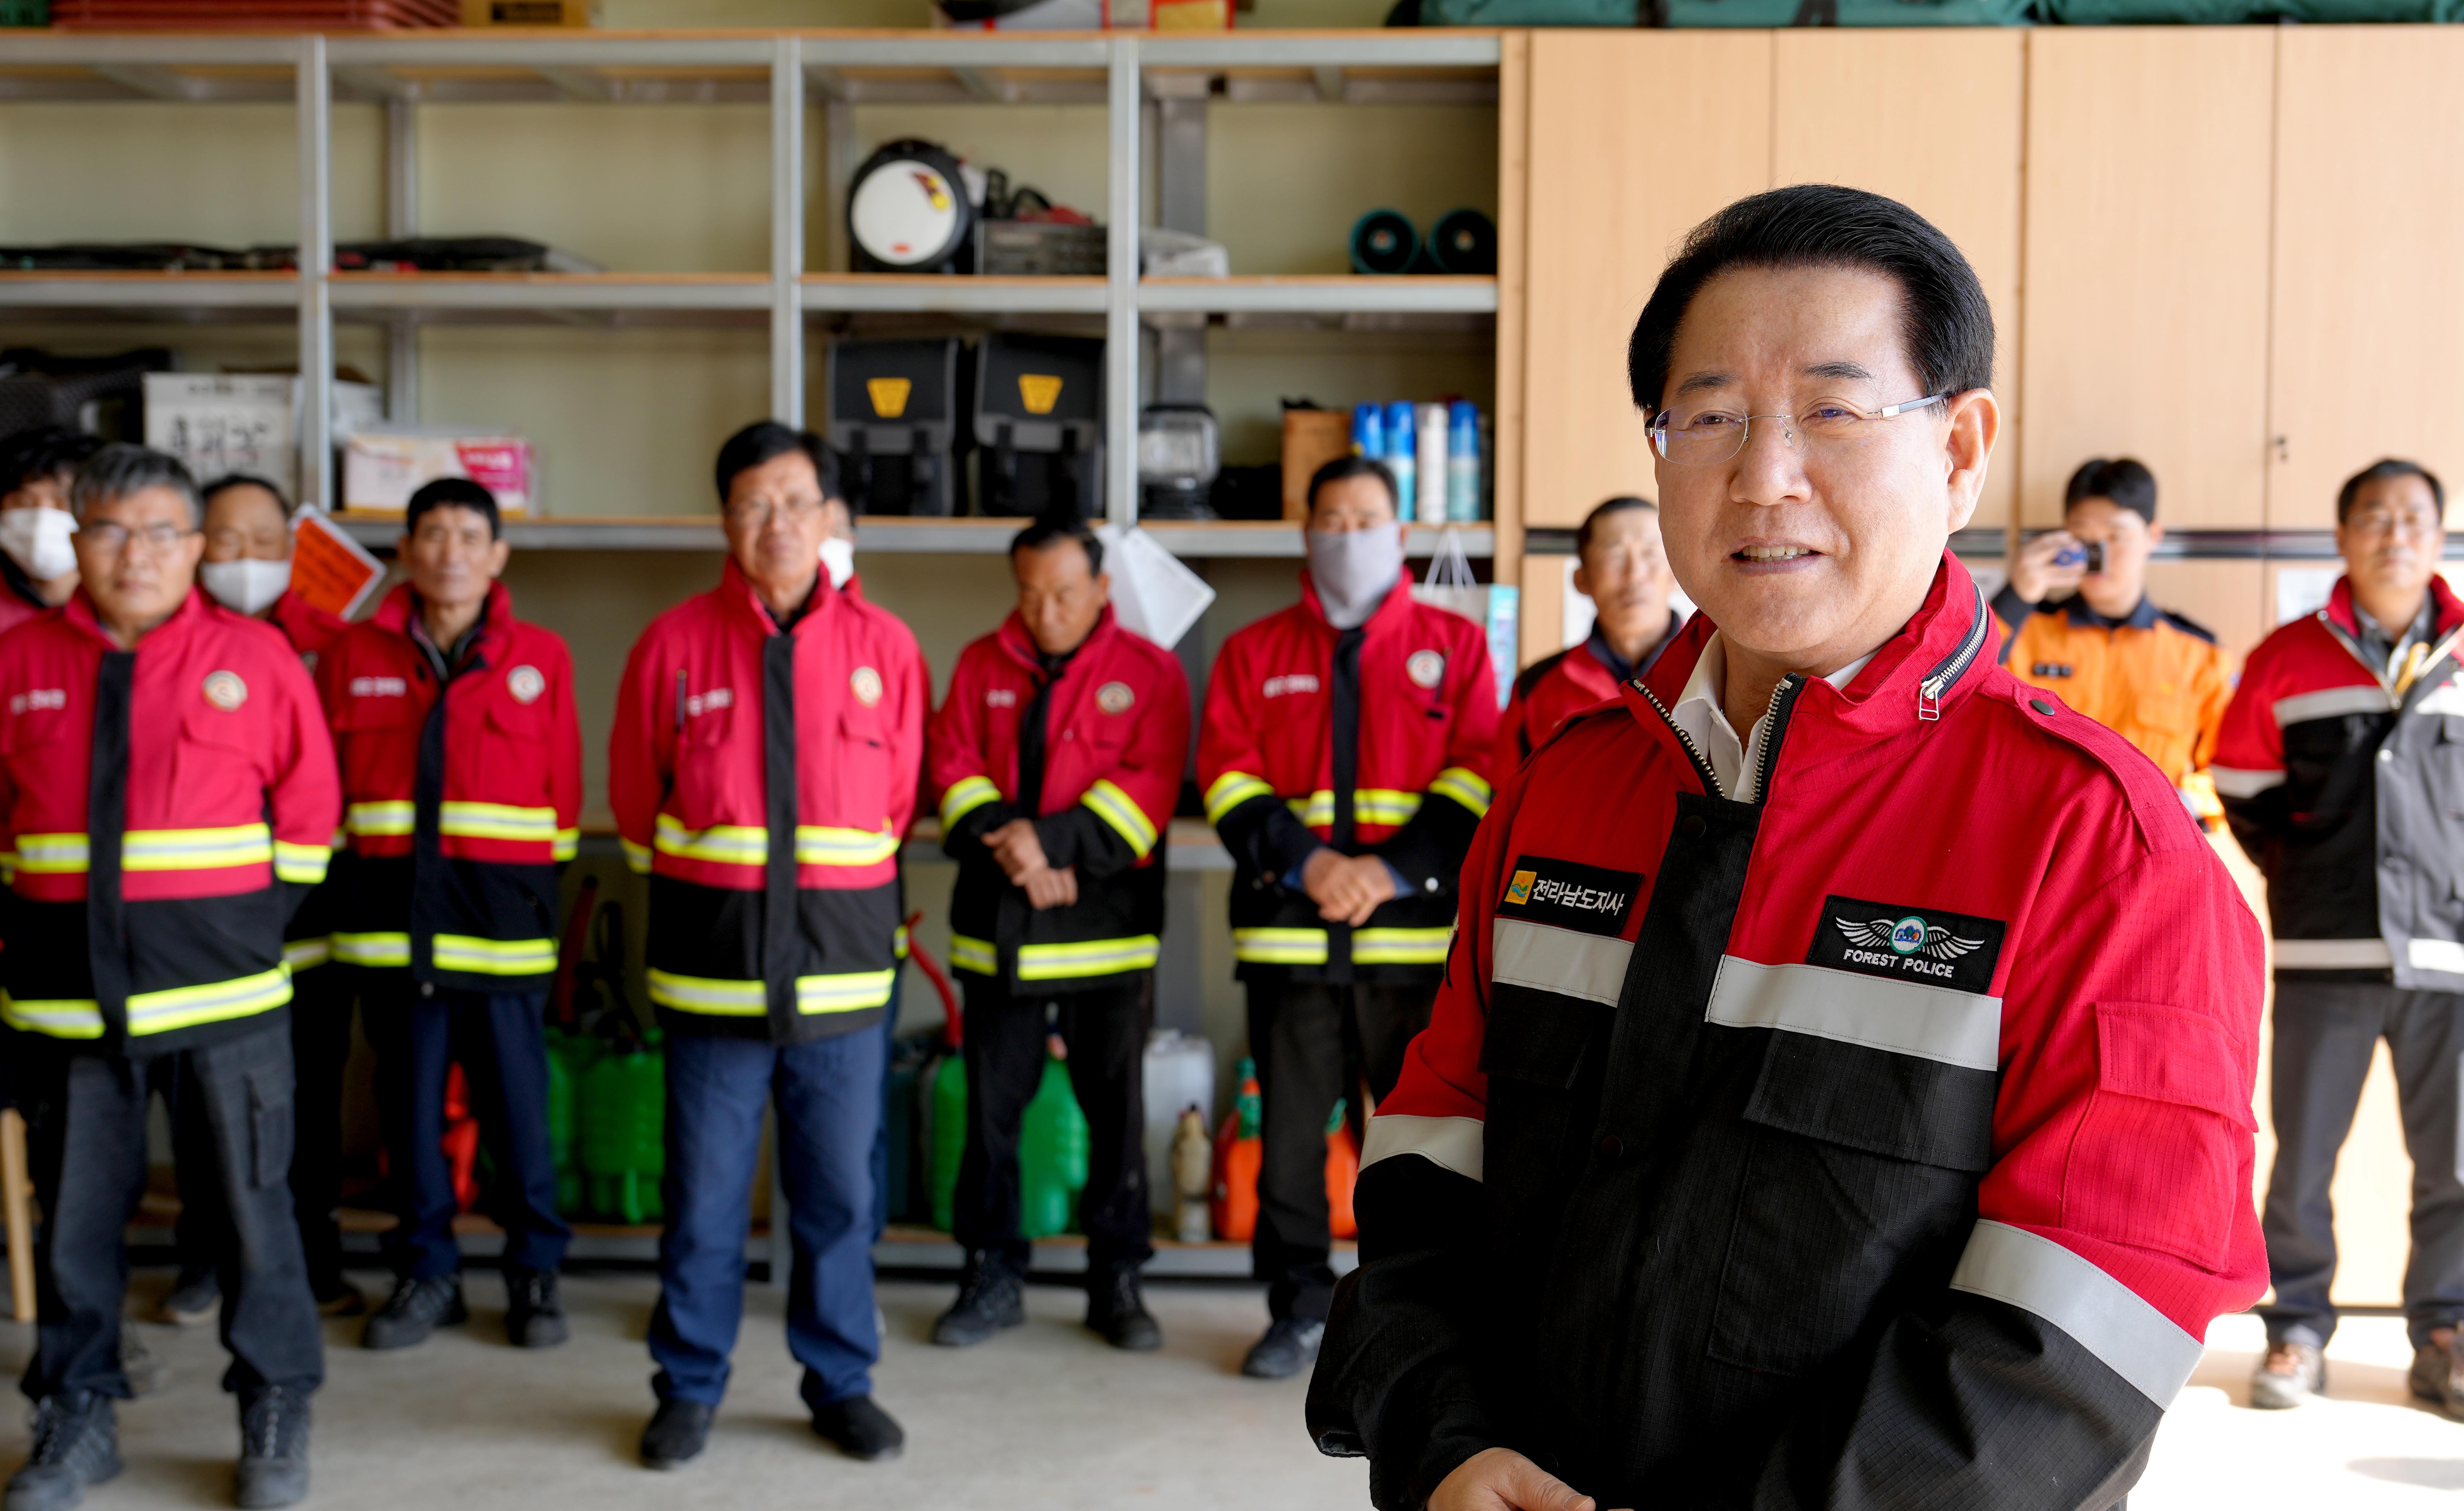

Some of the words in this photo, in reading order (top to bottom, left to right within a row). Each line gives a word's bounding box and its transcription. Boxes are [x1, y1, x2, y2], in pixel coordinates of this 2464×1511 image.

[1533, 879, 1625, 916] 전라남도지사
[1843, 948, 1899, 968] FOREST
[1902, 958, 1954, 978] POLICE
